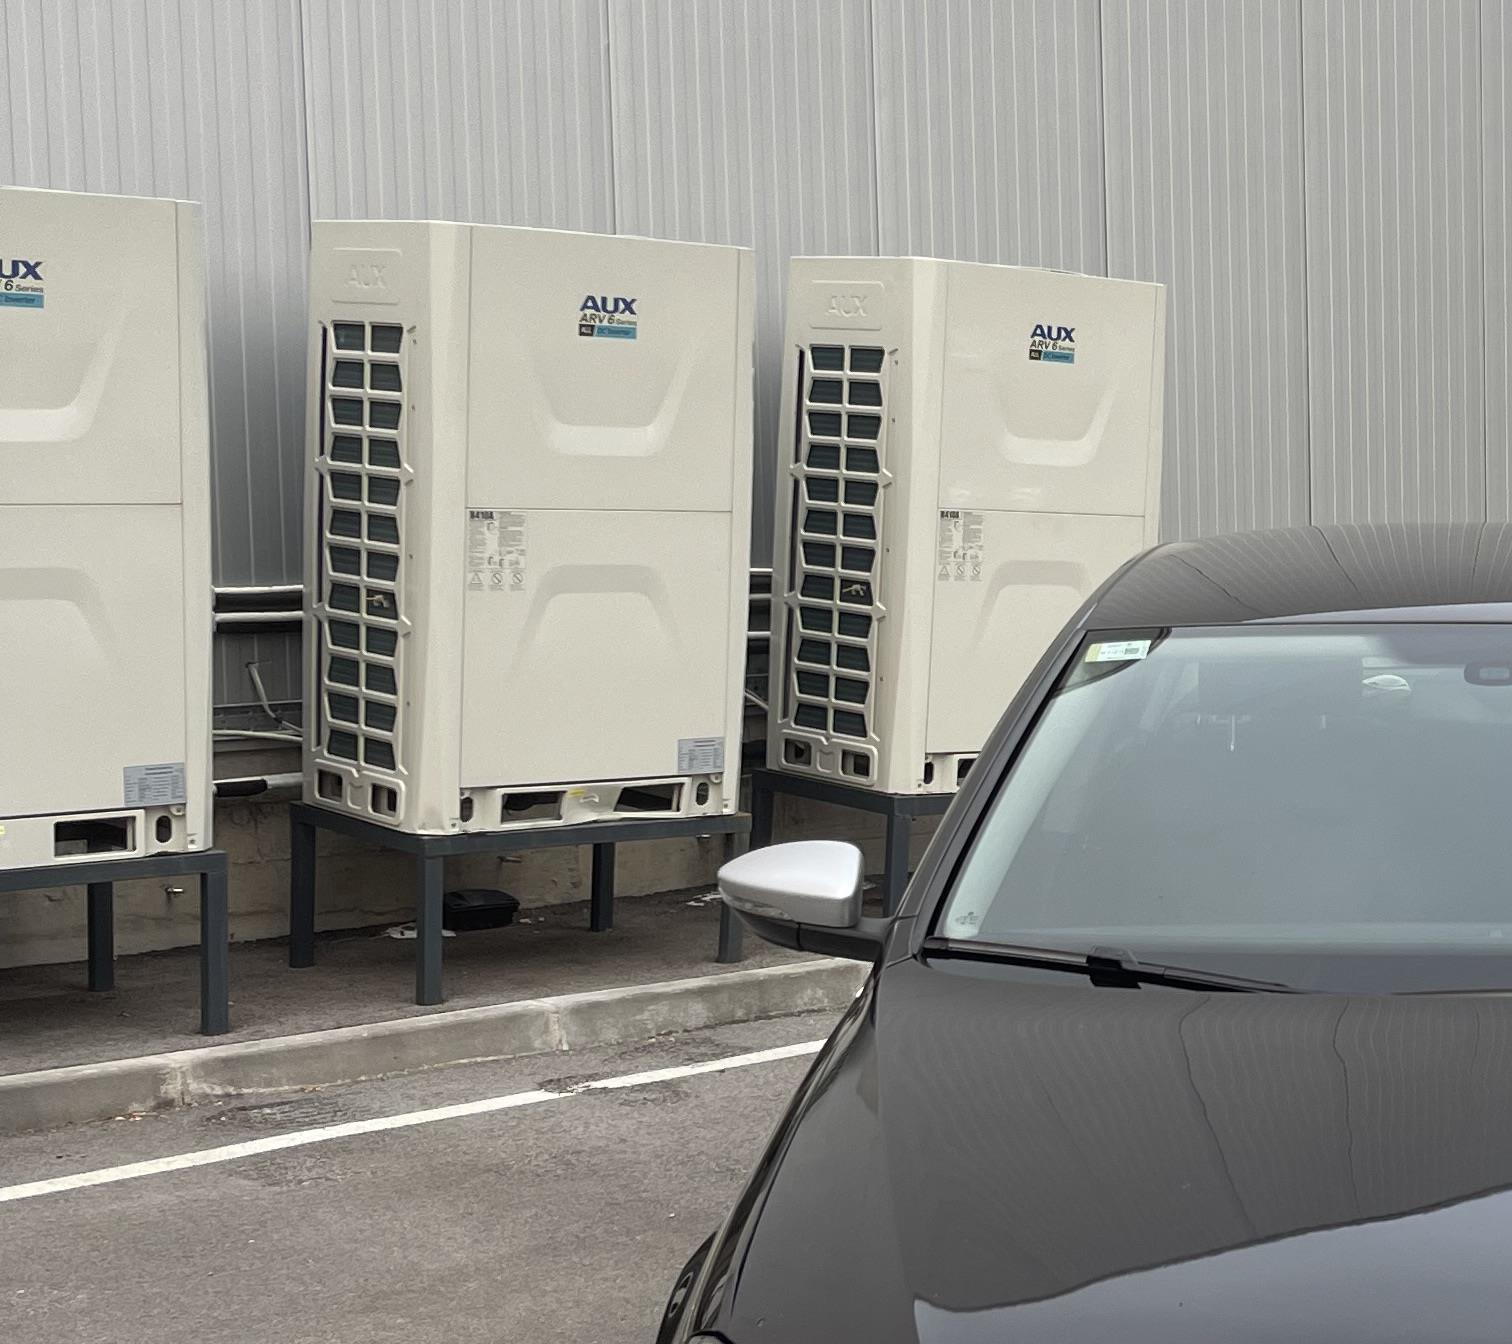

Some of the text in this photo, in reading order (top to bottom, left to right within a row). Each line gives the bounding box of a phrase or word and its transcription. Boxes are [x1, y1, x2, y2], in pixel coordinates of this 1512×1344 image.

[0, 259, 43, 280] UX
[4, 279, 14, 291] 6
[580, 295, 637, 315] AUX
[824, 295, 868, 318] AUX
[579, 313, 606, 324] ARV
[607, 314, 616, 325] 6
[1031, 324, 1075, 343] AUX
[1030, 339, 1051, 350] ARV
[1051, 341, 1059, 351] 6
